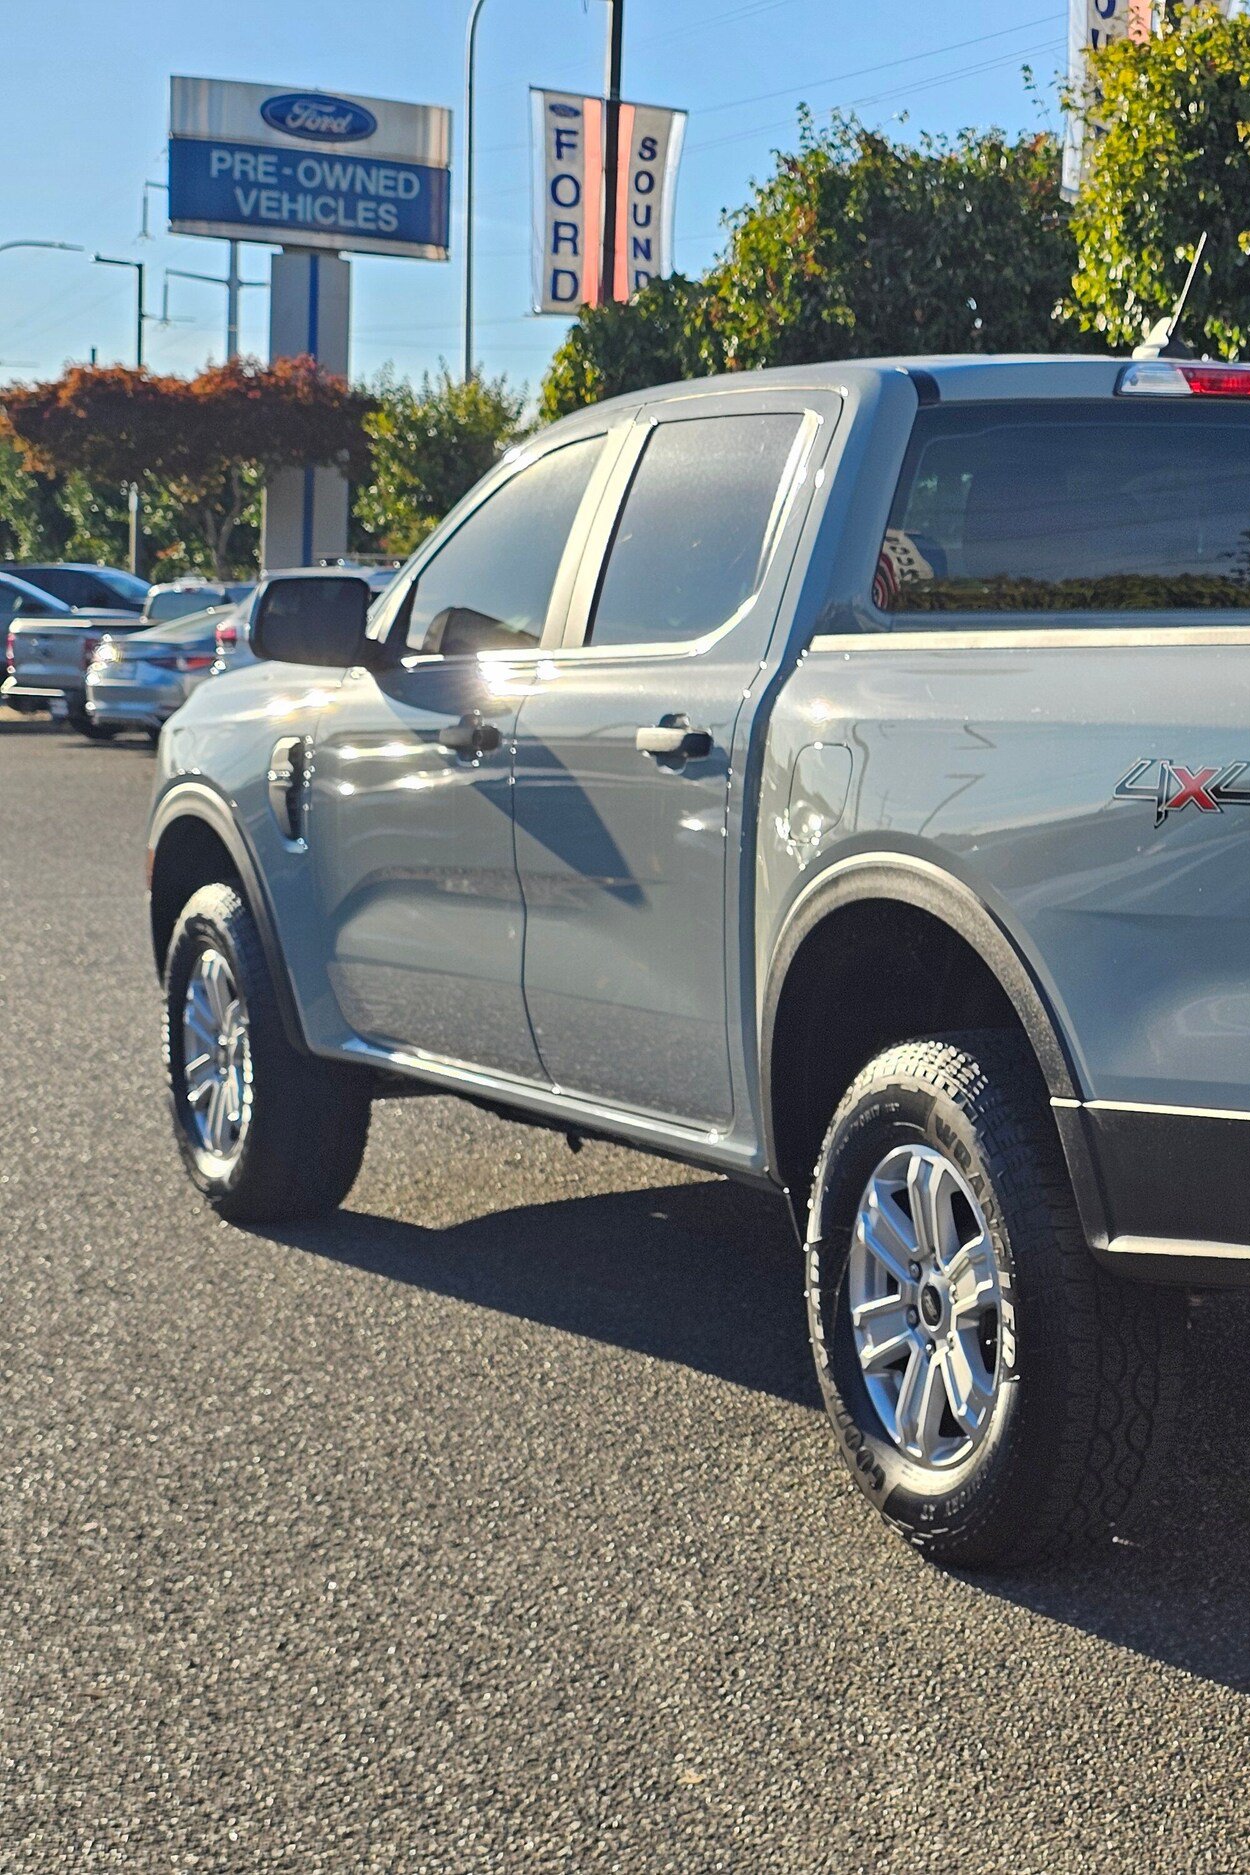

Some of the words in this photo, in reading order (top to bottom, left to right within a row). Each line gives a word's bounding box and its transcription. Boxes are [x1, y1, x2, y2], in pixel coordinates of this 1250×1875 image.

[209, 149, 420, 200] PRE-OWNED
[234, 185, 399, 232] VEHICLES
[551, 128, 580, 301] FORD
